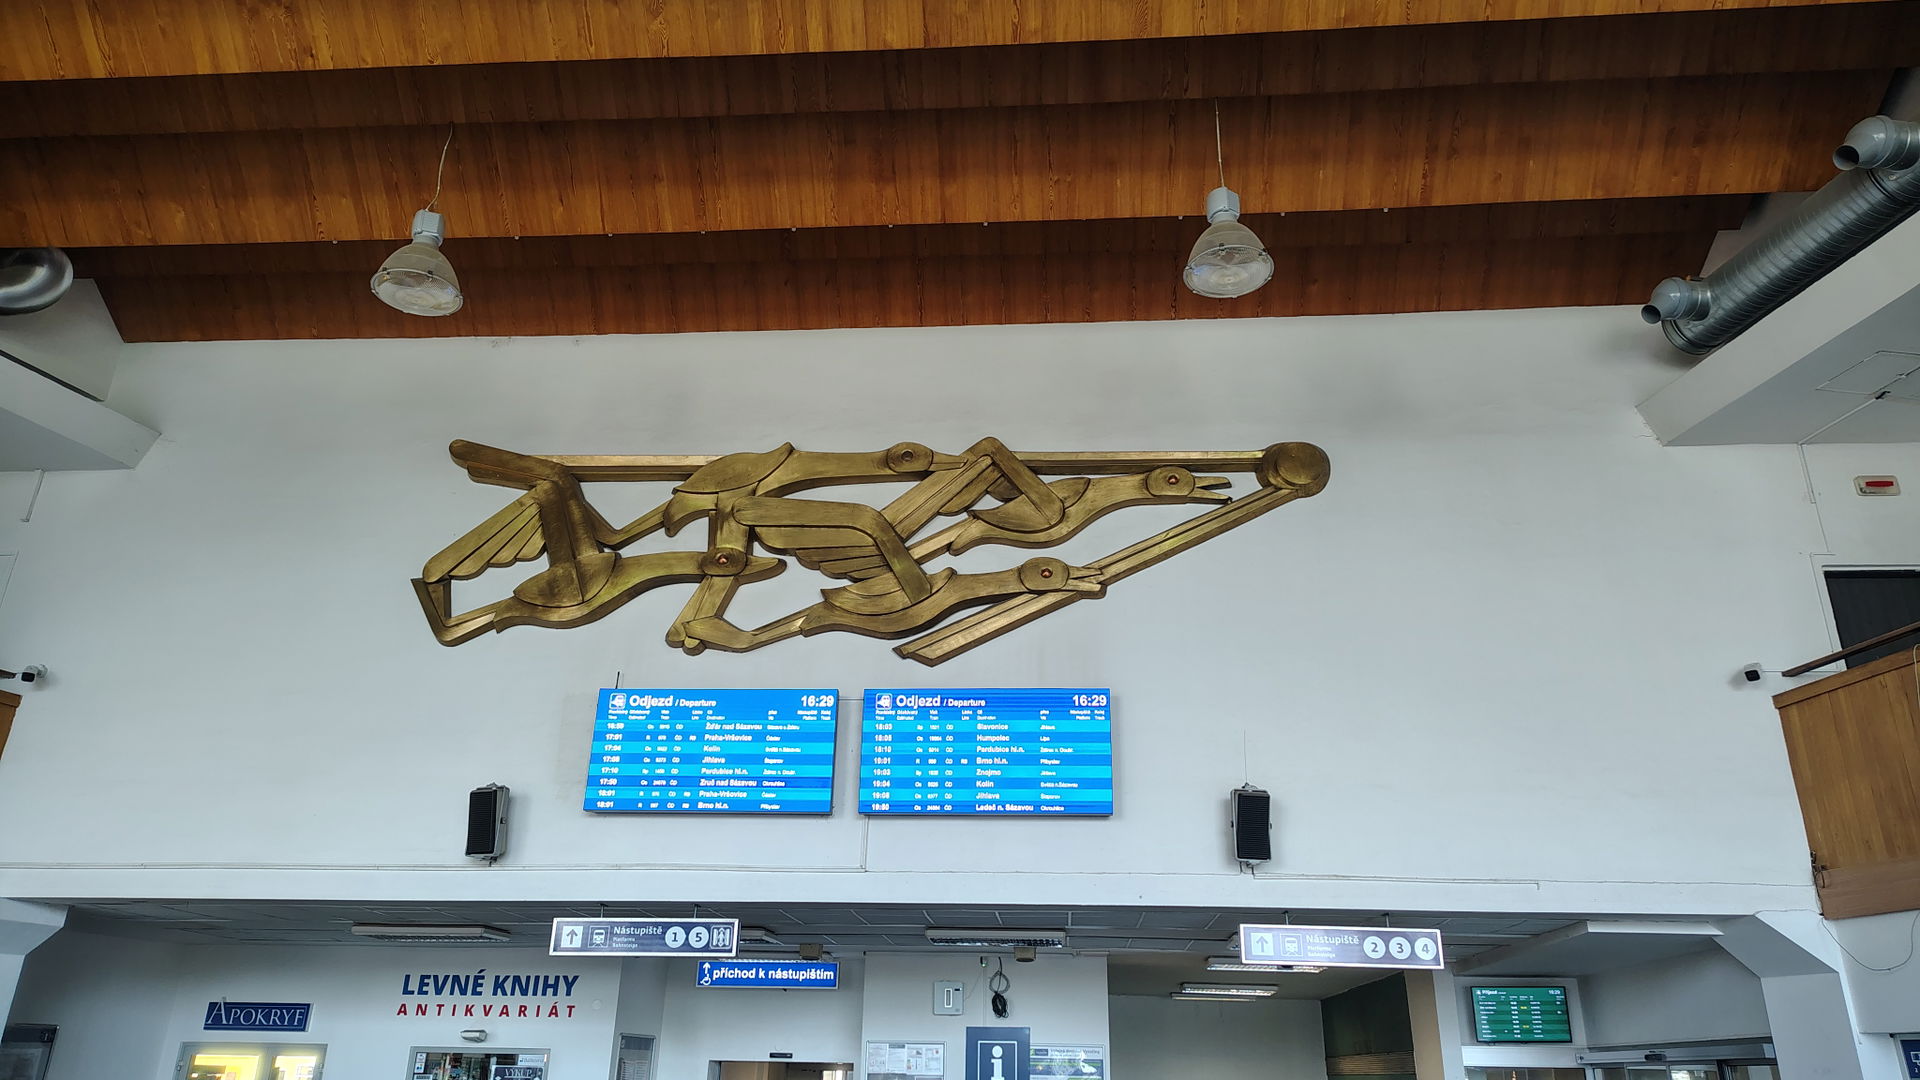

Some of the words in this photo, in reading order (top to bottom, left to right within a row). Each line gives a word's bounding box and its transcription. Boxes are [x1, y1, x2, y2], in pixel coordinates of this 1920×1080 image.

[629, 695, 674, 709] Odjezd
[680, 699, 716, 708] Departure
[801, 695, 834, 707] 16:29
[896, 695, 940, 709] Odjezd
[948, 699, 986, 708] Departure
[1072, 695, 1107, 706] 16:29
[976, 768, 1001, 777] Znojmo
[613, 925, 663, 936] Nástupiště
[672, 932, 678, 942] 1
[695, 932, 702, 943] 5
[1306, 934, 1359, 945] Nástupiště
[1371, 942, 1379, 952] 2
[1396, 942, 1404, 953] 3
[1421, 943, 1430, 953] 4
[712, 967, 756, 980] příchod
[759, 968, 765, 978] k
[768, 968, 834, 981] nástupištím
[402, 969, 487, 996] LEVNÉ
[492, 975, 580, 996] KNIHY
[397, 1002, 576, 1017] ANTIKVARIÁT
